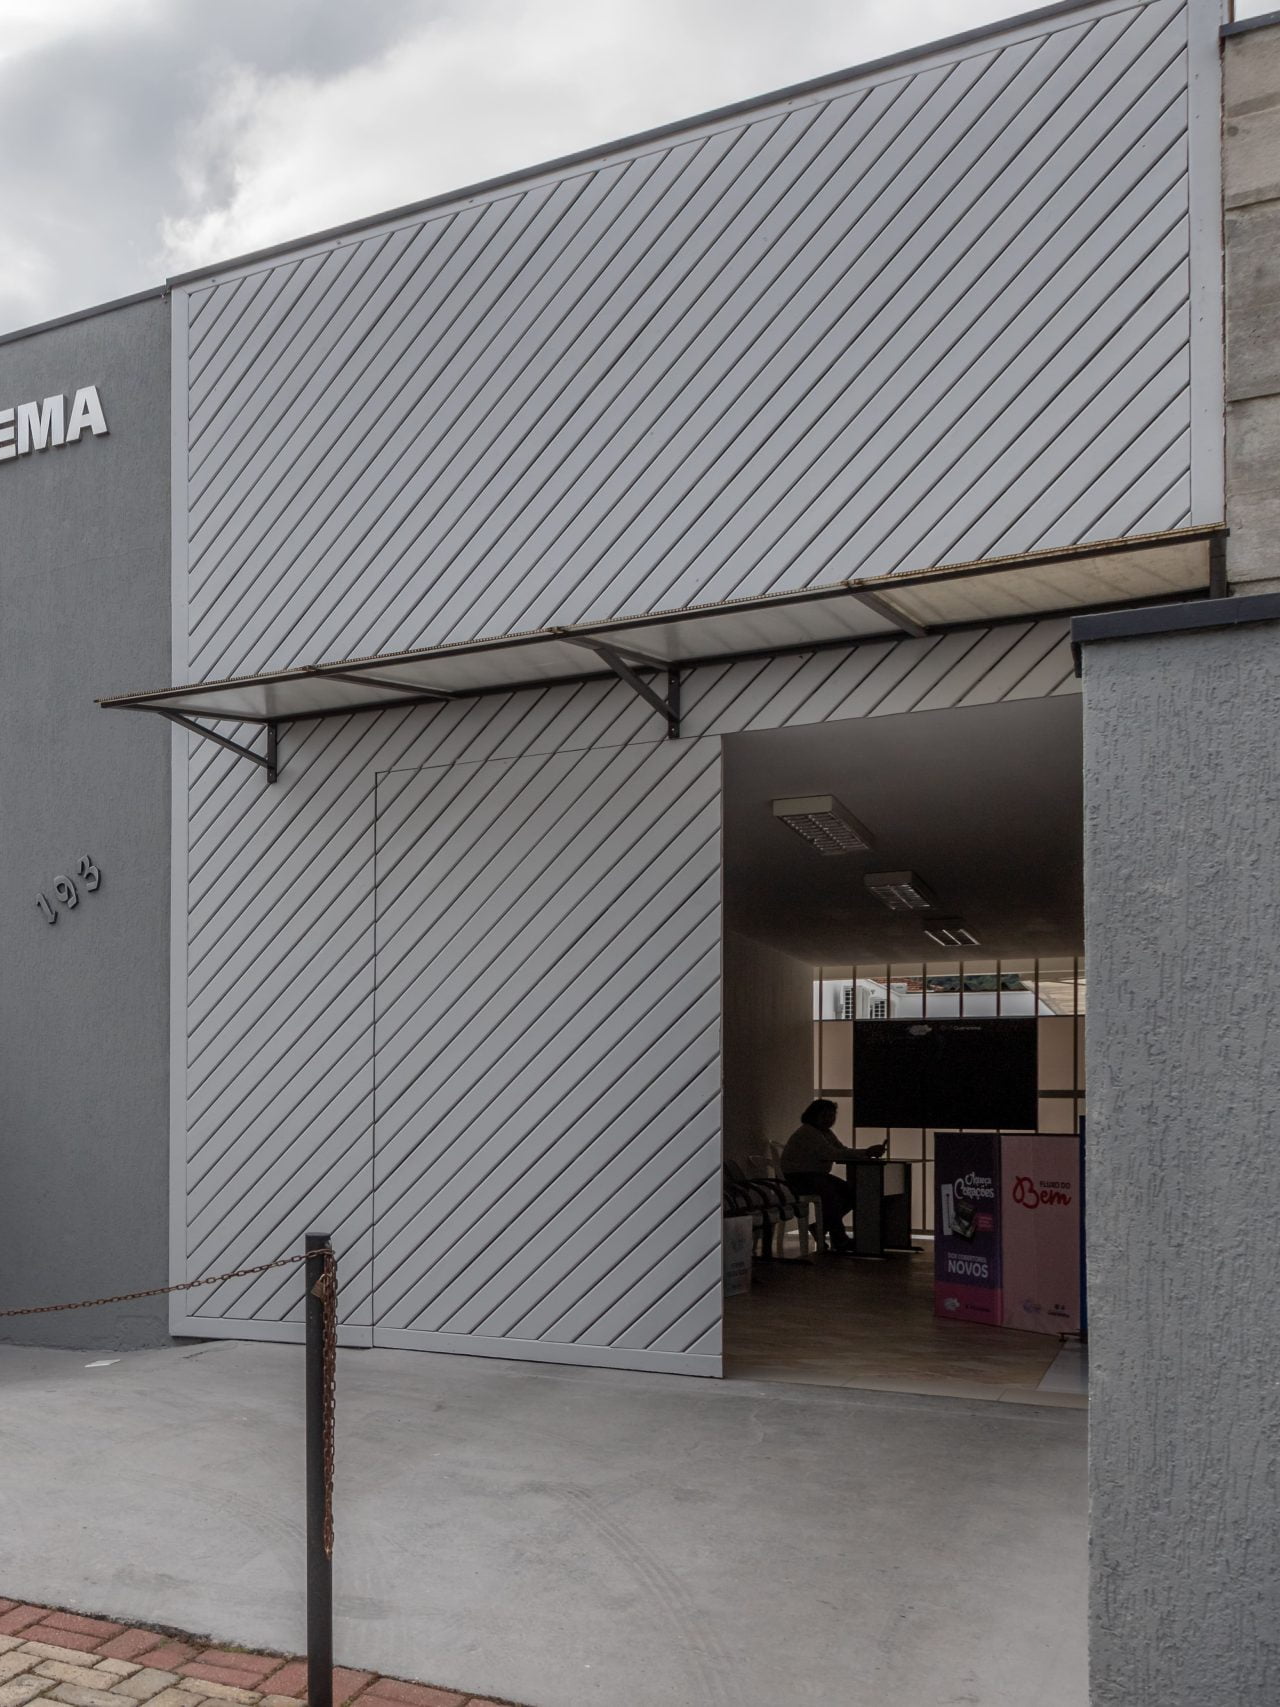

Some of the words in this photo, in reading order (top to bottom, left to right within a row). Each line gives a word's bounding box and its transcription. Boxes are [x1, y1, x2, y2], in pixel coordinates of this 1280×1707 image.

[35, 854, 101, 924] 193
[1012, 1175, 1072, 1209] Bem
[948, 1260, 988, 1278] NOVOS
